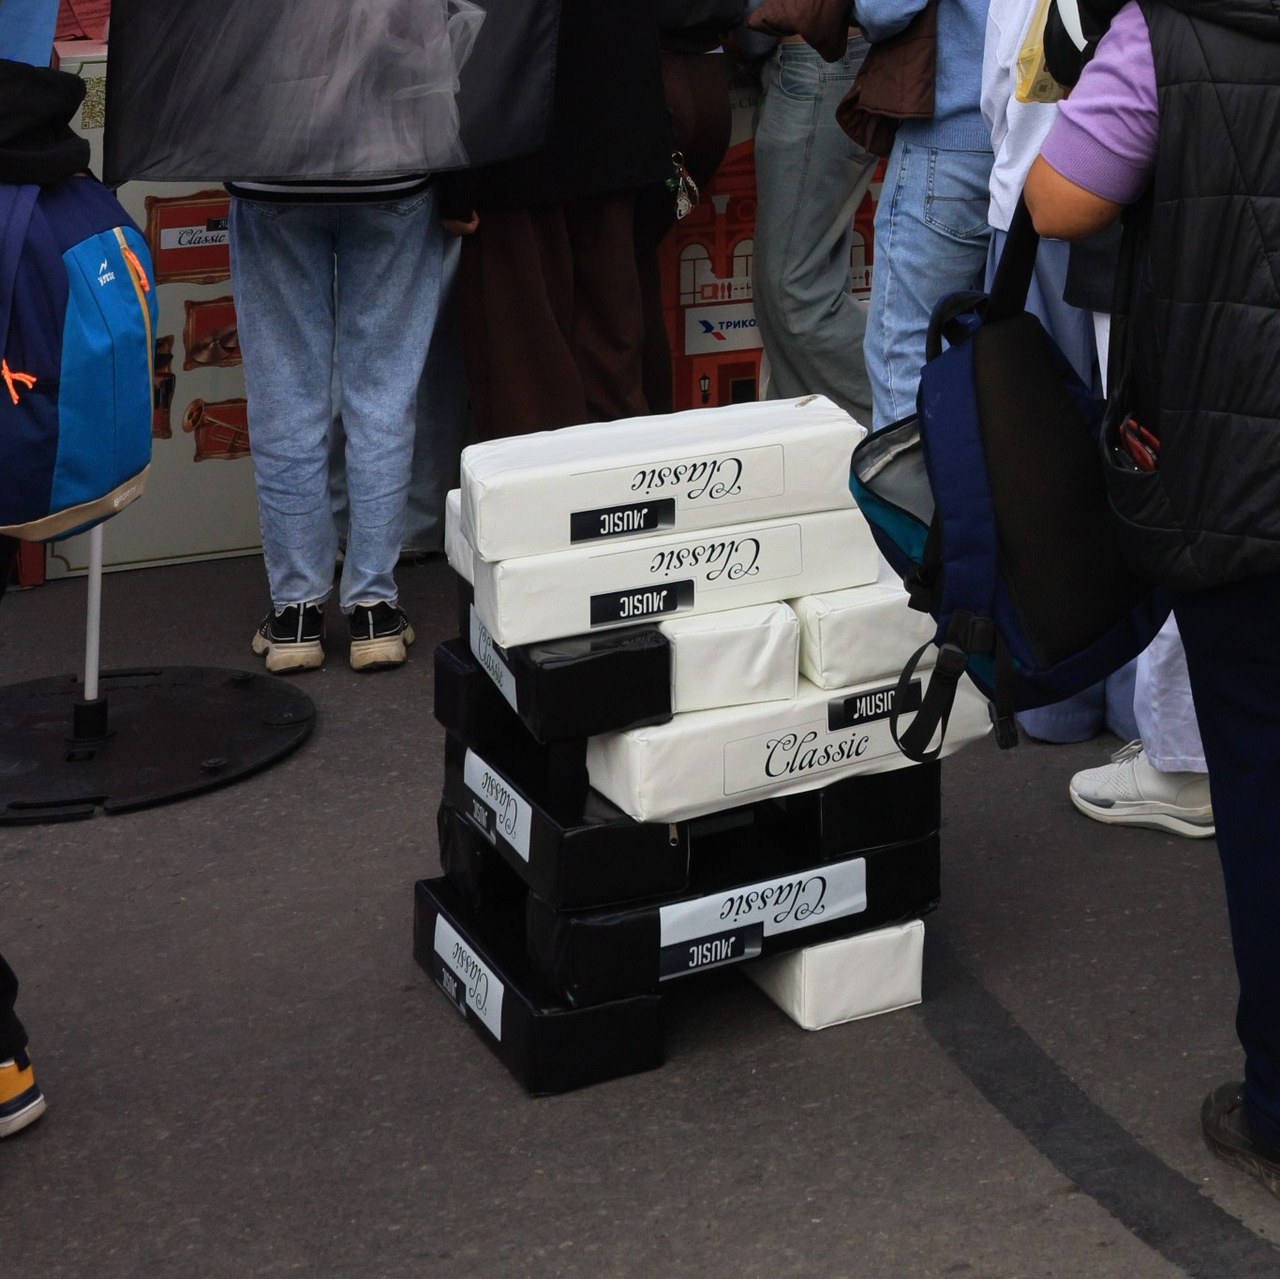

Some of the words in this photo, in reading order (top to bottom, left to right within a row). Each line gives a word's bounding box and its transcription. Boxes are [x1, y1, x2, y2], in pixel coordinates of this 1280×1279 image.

[179, 229, 225, 246] Classic
[718, 319, 757, 330] ТРИКО
[631, 457, 743, 499] Classic
[601, 508, 648, 534] MUSIC
[650, 538, 760, 581] Classic
[620, 590, 667, 618] MUSIC
[479, 623, 503, 687] Classic
[853, 691, 895, 719] MUSIC
[765, 731, 869, 777] Classic
[482, 772, 518, 839] Classic
[720, 876, 827, 924] Classic
[689, 936, 736, 967] MUSIC
[452, 942, 488, 1016] Classic
